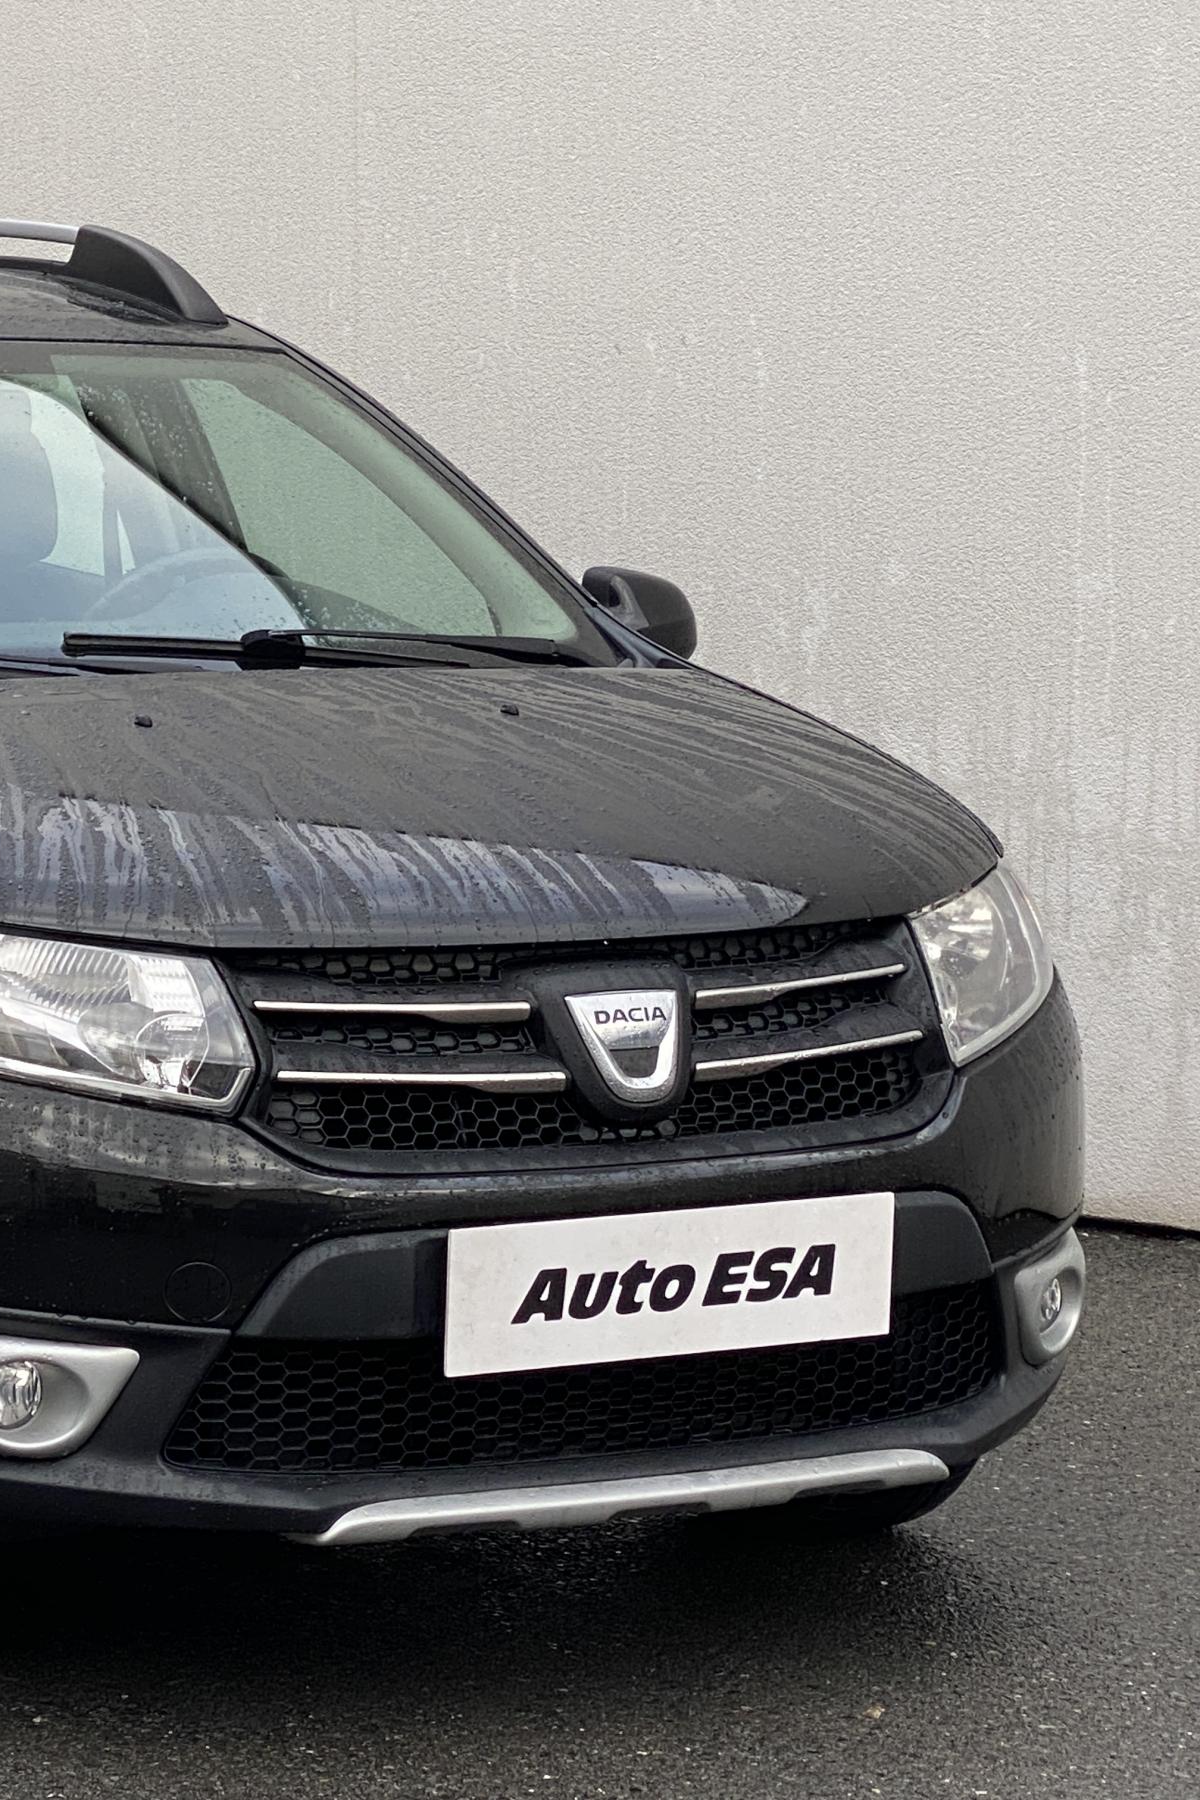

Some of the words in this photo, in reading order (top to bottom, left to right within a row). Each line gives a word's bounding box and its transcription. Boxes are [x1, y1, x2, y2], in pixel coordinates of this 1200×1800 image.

[594, 1006, 667, 1025] DACIA
[510, 1259, 697, 1325] Auto
[701, 1243, 836, 1307] ESA
